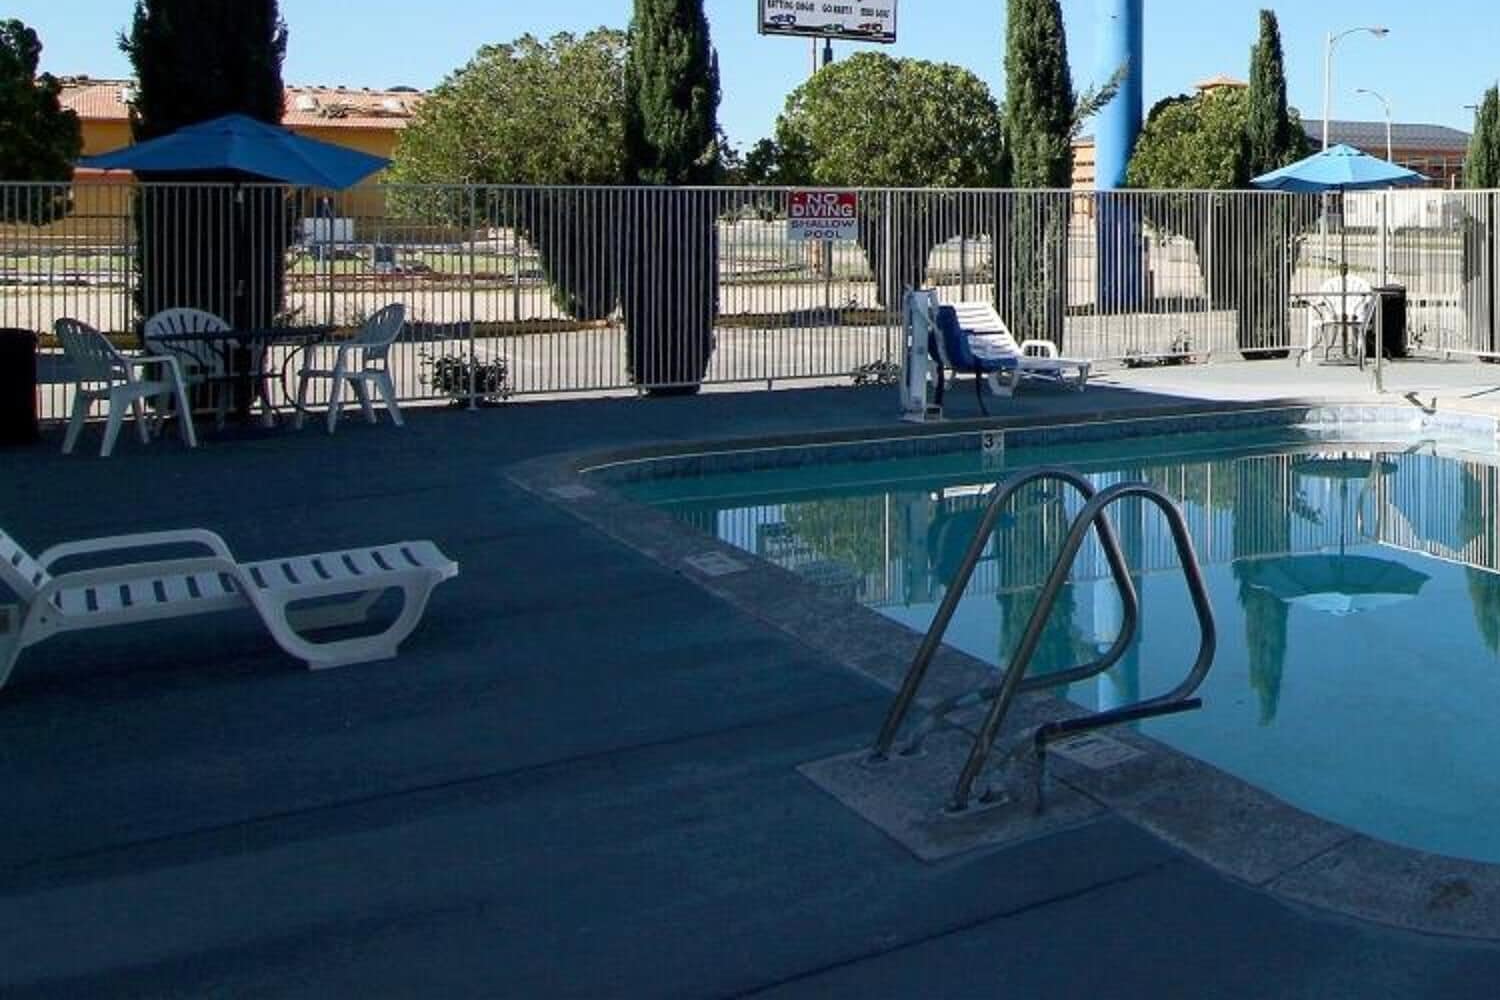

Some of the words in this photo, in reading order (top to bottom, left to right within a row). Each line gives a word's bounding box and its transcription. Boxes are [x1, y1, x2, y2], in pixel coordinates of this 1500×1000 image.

[807, 193, 839, 204] NO
[791, 203, 853, 217] DIVING
[791, 219, 855, 229] SHALLOW
[804, 229, 842, 239] POOL
[984, 432, 994, 449] 3
